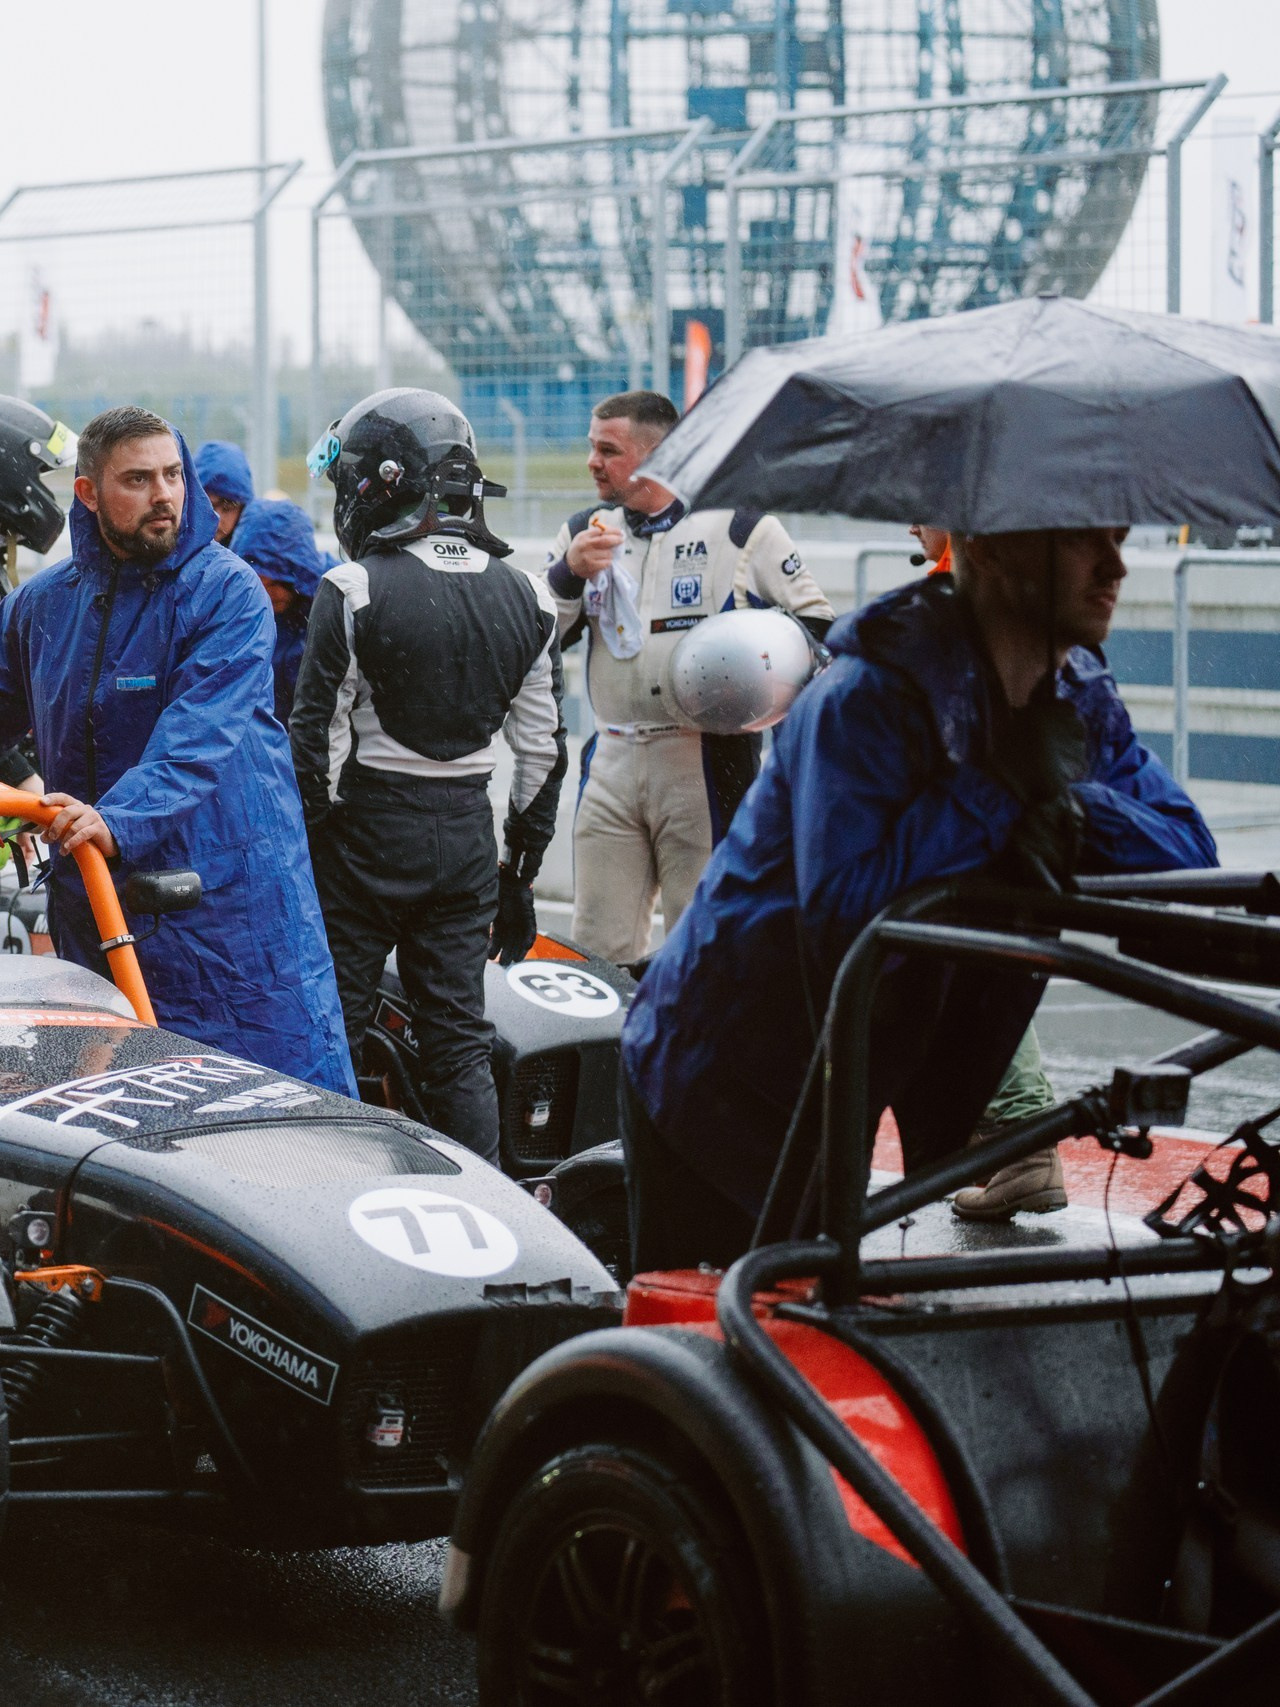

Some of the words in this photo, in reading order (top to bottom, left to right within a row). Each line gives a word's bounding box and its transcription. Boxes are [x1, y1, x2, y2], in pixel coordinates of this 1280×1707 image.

[434, 544, 468, 556] OMP
[665, 618, 701, 630] YOKOHA
[519, 973, 609, 1003] 63
[361, 1204, 489, 1255] 77
[229, 1317, 319, 1389] YOKOHAMA
